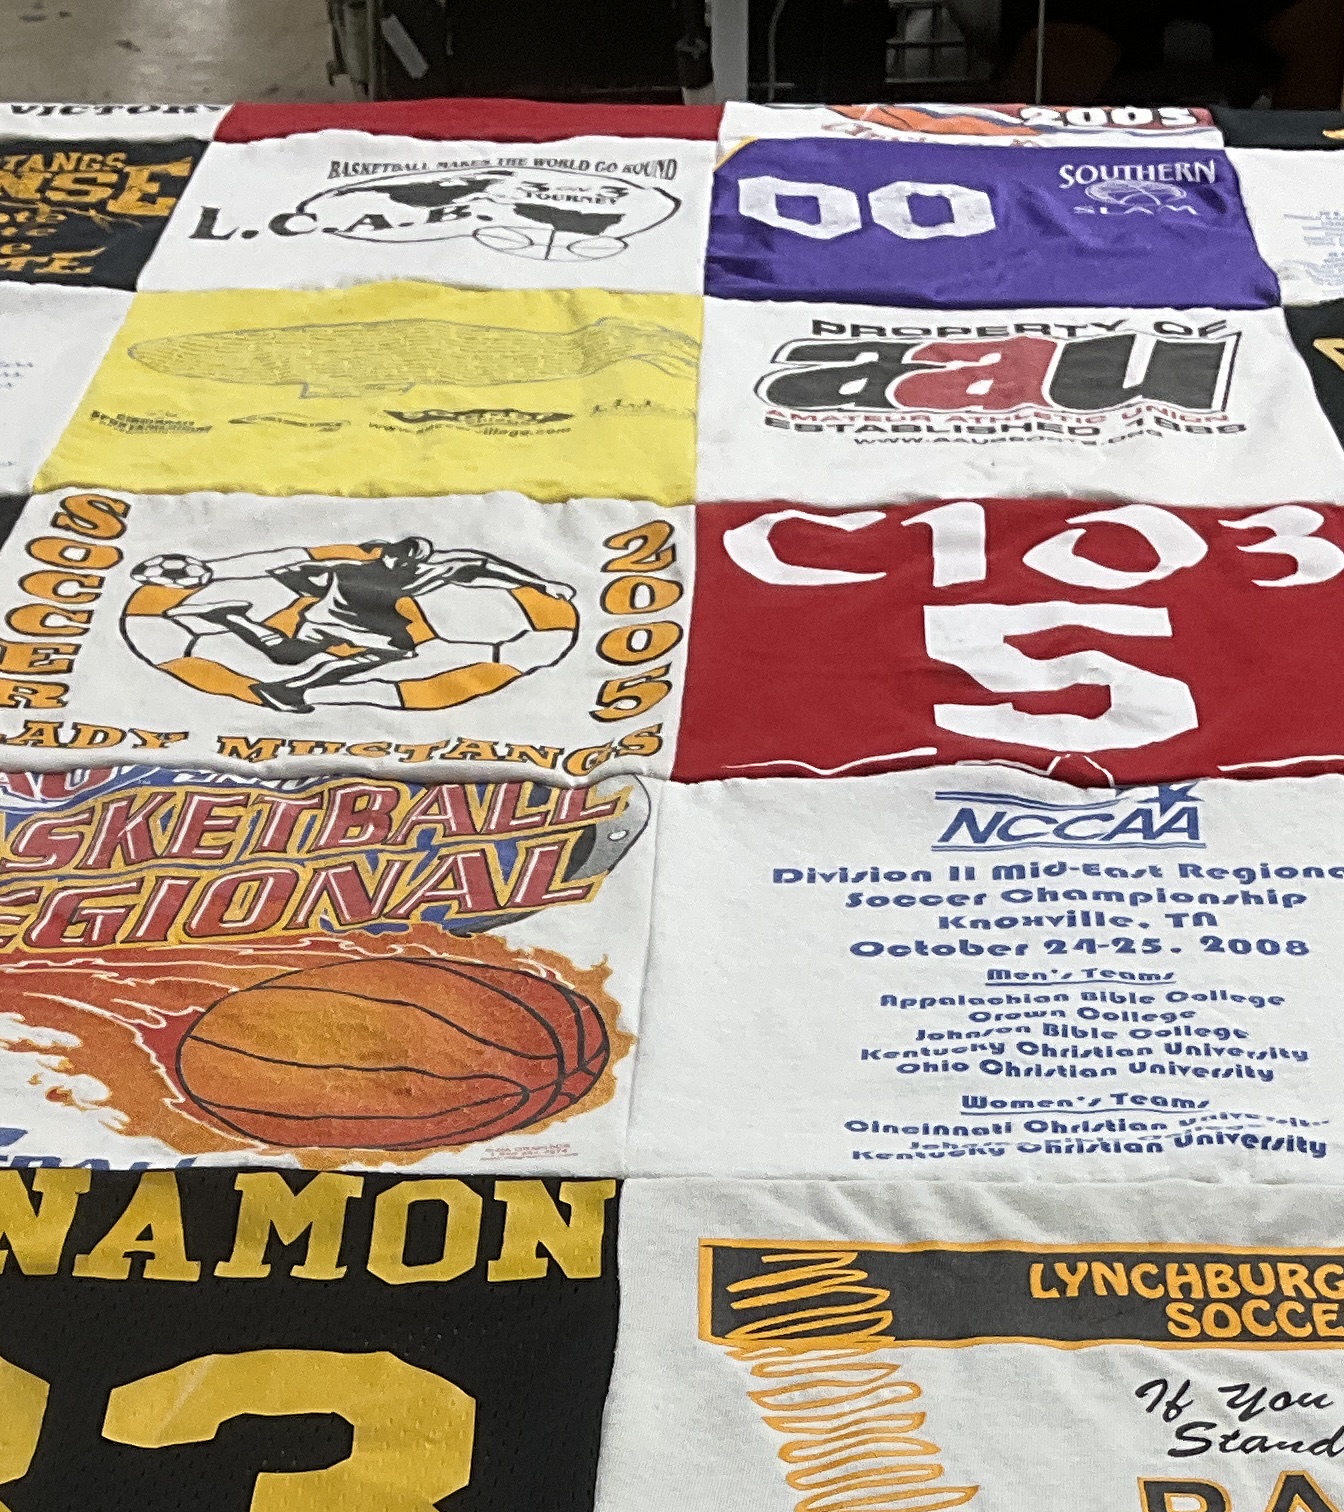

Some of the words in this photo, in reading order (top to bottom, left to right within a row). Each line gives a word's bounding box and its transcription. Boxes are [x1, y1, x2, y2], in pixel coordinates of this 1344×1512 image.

[1020, 106, 1199, 127] 2005
[327, 160, 429, 180] BASKETBALL
[534, 157, 589, 171] WORLD
[595, 161, 617, 173] GO
[622, 158, 678, 181] ROUND
[1059, 158, 1218, 190] SOUTHERN
[738, 175, 997, 241] 00
[190, 203, 493, 240] L.C.A.B.
[812, 318, 1128, 338] PROPERTY
[1153, 319, 1233, 338] OF
[764, 416, 1101, 436] ESTABLISHED
[591, 520, 684, 724] 2005
[923, 600, 1199, 752] 5
[217, 722, 664, 780] MUSTANGS
[937, 805, 1201, 844] NCCAA
[773, 865, 933, 884] Division
[992, 860, 1163, 881] Mid-East
[844, 892, 987, 908] Soccer
[1000, 886, 1308, 909] Championship
[1164, 911, 1219, 929] TN
[849, 938, 1030, 957] October
[1199, 935, 1311, 957] 2008
[986, 968, 1073, 981] Men's
[1081, 968, 1174, 981] Teams
[879, 992, 1070, 1010] Appalachian
[1081, 991, 1156, 1005] Bible
[1165, 989, 1286, 1009] College
[968, 1008, 1067, 1023] Crown
[1076, 1006, 1197, 1024] College
[915, 1024, 1031, 1042] Johnson
[1042, 1021, 1119, 1040] Bible
[1128, 1025, 1250, 1041] College
[860, 1040, 1006, 1061] Kentucky
[1016, 1040, 1154, 1059] Christian
[1163, 1041, 1310, 1062] University
[895, 1059, 970, 1075] Ohio
[978, 1058, 1118, 1078] Christian
[1128, 1060, 1275, 1083] University
[961, 1094, 1102, 1110] Women's
[1109, 1091, 1210, 1109] Teams
[844, 1119, 1013, 1137] Cincinnati
[1023, 1118, 1168, 1134] Christian
[1173, 1130, 1328, 1159] University
[1135, 1378, 1194, 1420] If
[1227, 1380, 1336, 1421] You
